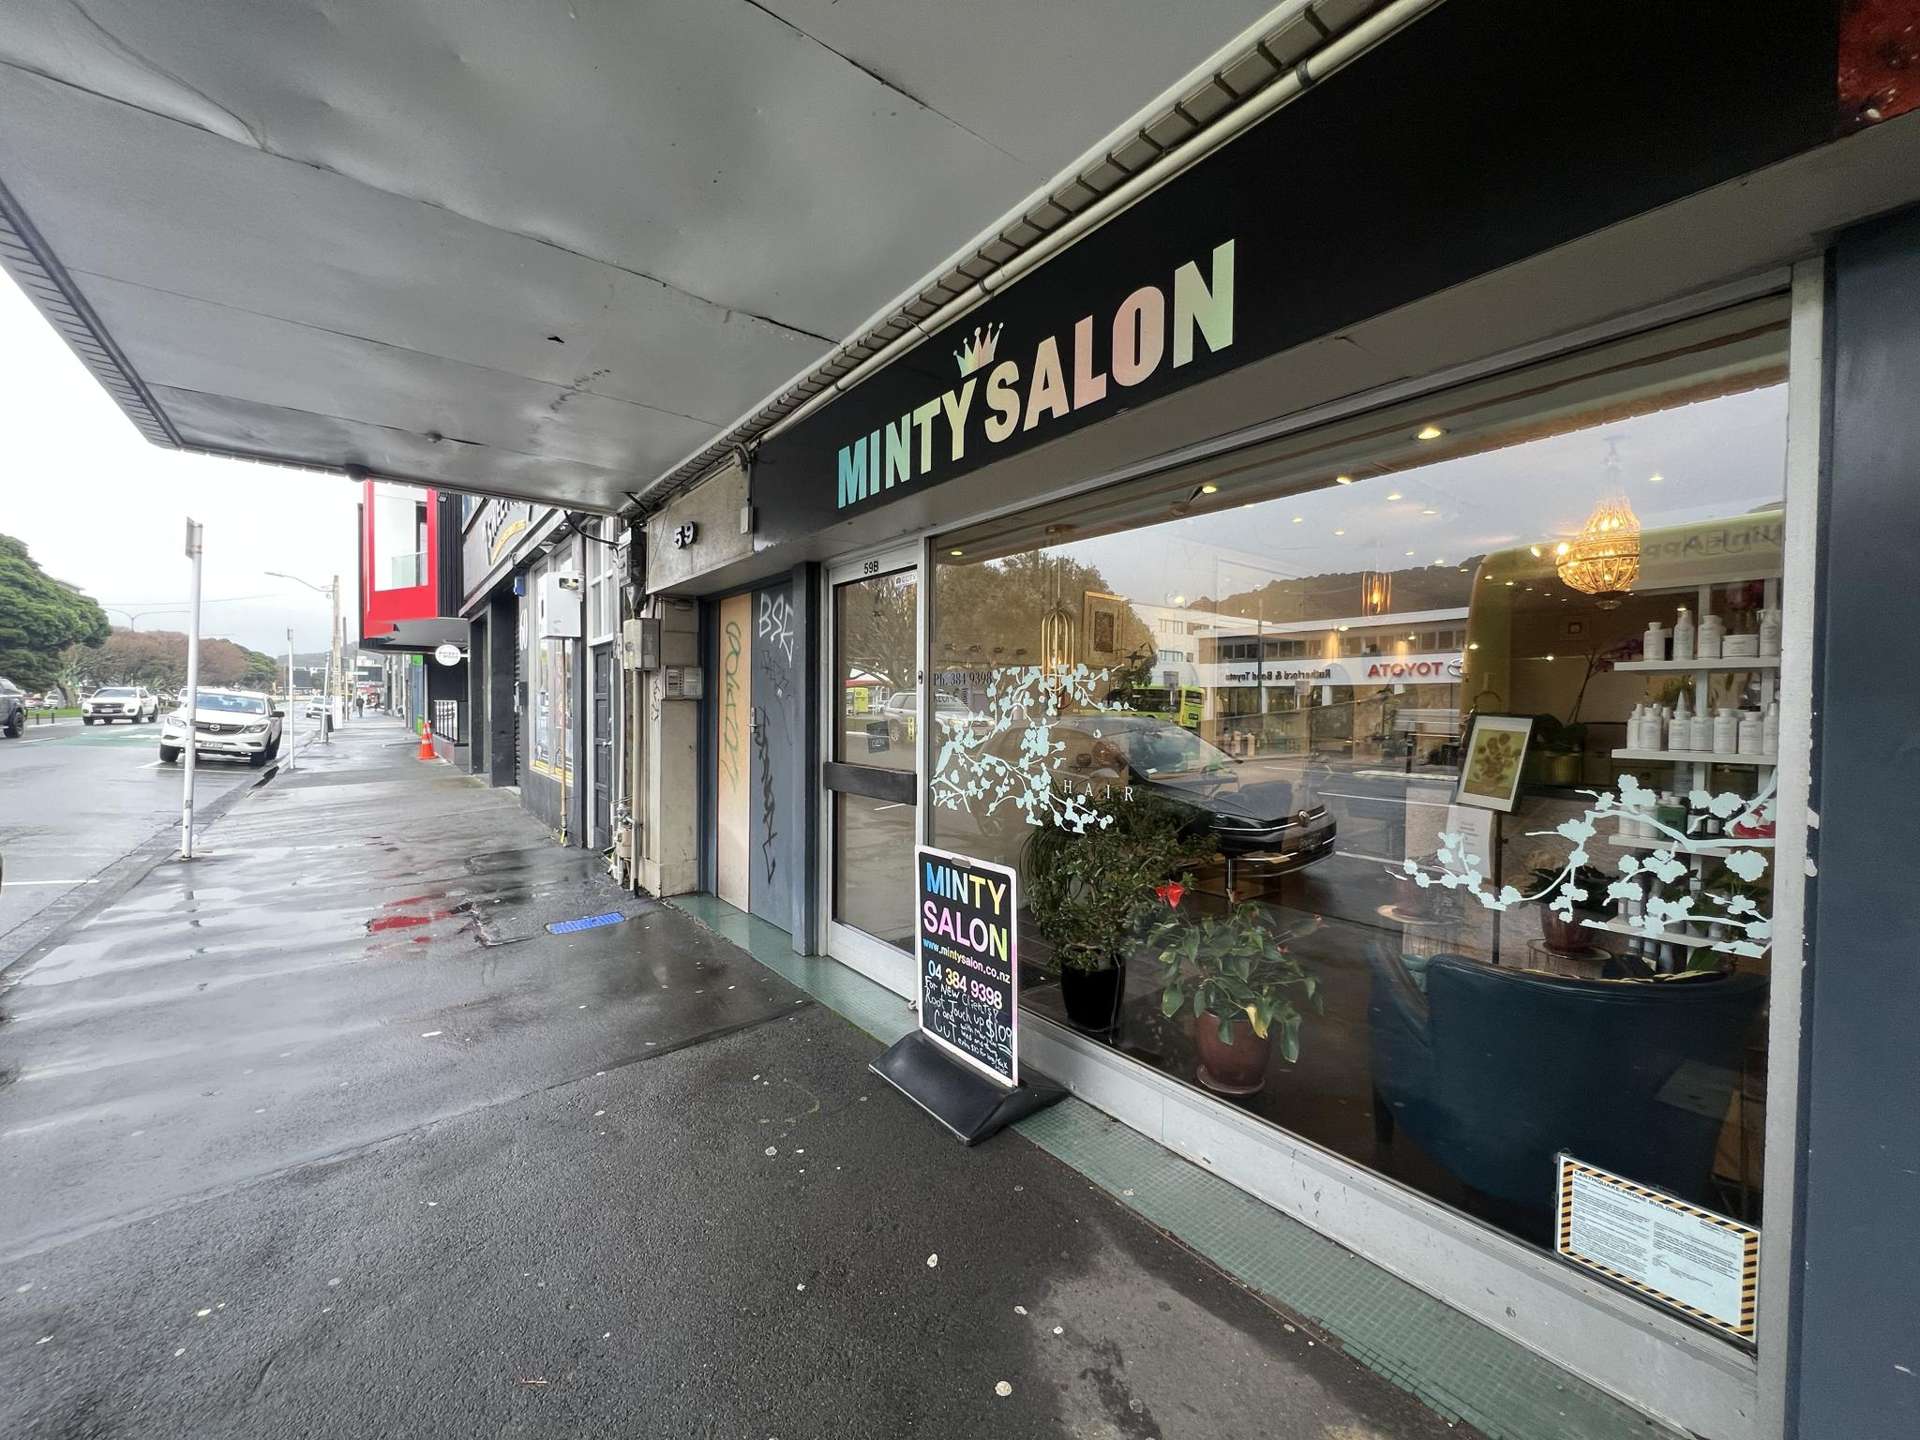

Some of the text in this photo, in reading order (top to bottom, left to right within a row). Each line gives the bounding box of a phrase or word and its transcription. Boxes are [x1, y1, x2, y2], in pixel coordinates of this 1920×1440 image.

[837, 238, 1236, 510] MINTY SALON
[674, 521, 696, 549] 59
[863, 560, 879, 575] 59B
[519, 608, 528, 650] 60
[934, 673, 948, 686] Ph.
[969, 671, 993, 686] 9398
[1063, 780, 1134, 802] HAIR
[925, 861, 1007, 916] MINTY
[923, 900, 1009, 962] SALON
[923, 937, 1011, 985] www.mintysalon.co.nz
[924, 975, 938, 991] For
[928, 959, 1003, 1010] 04 384 9398
[925, 987, 945, 1010] Root
[948, 1000, 972, 1025] Touch
[985, 1015, 1013, 1049] $109
